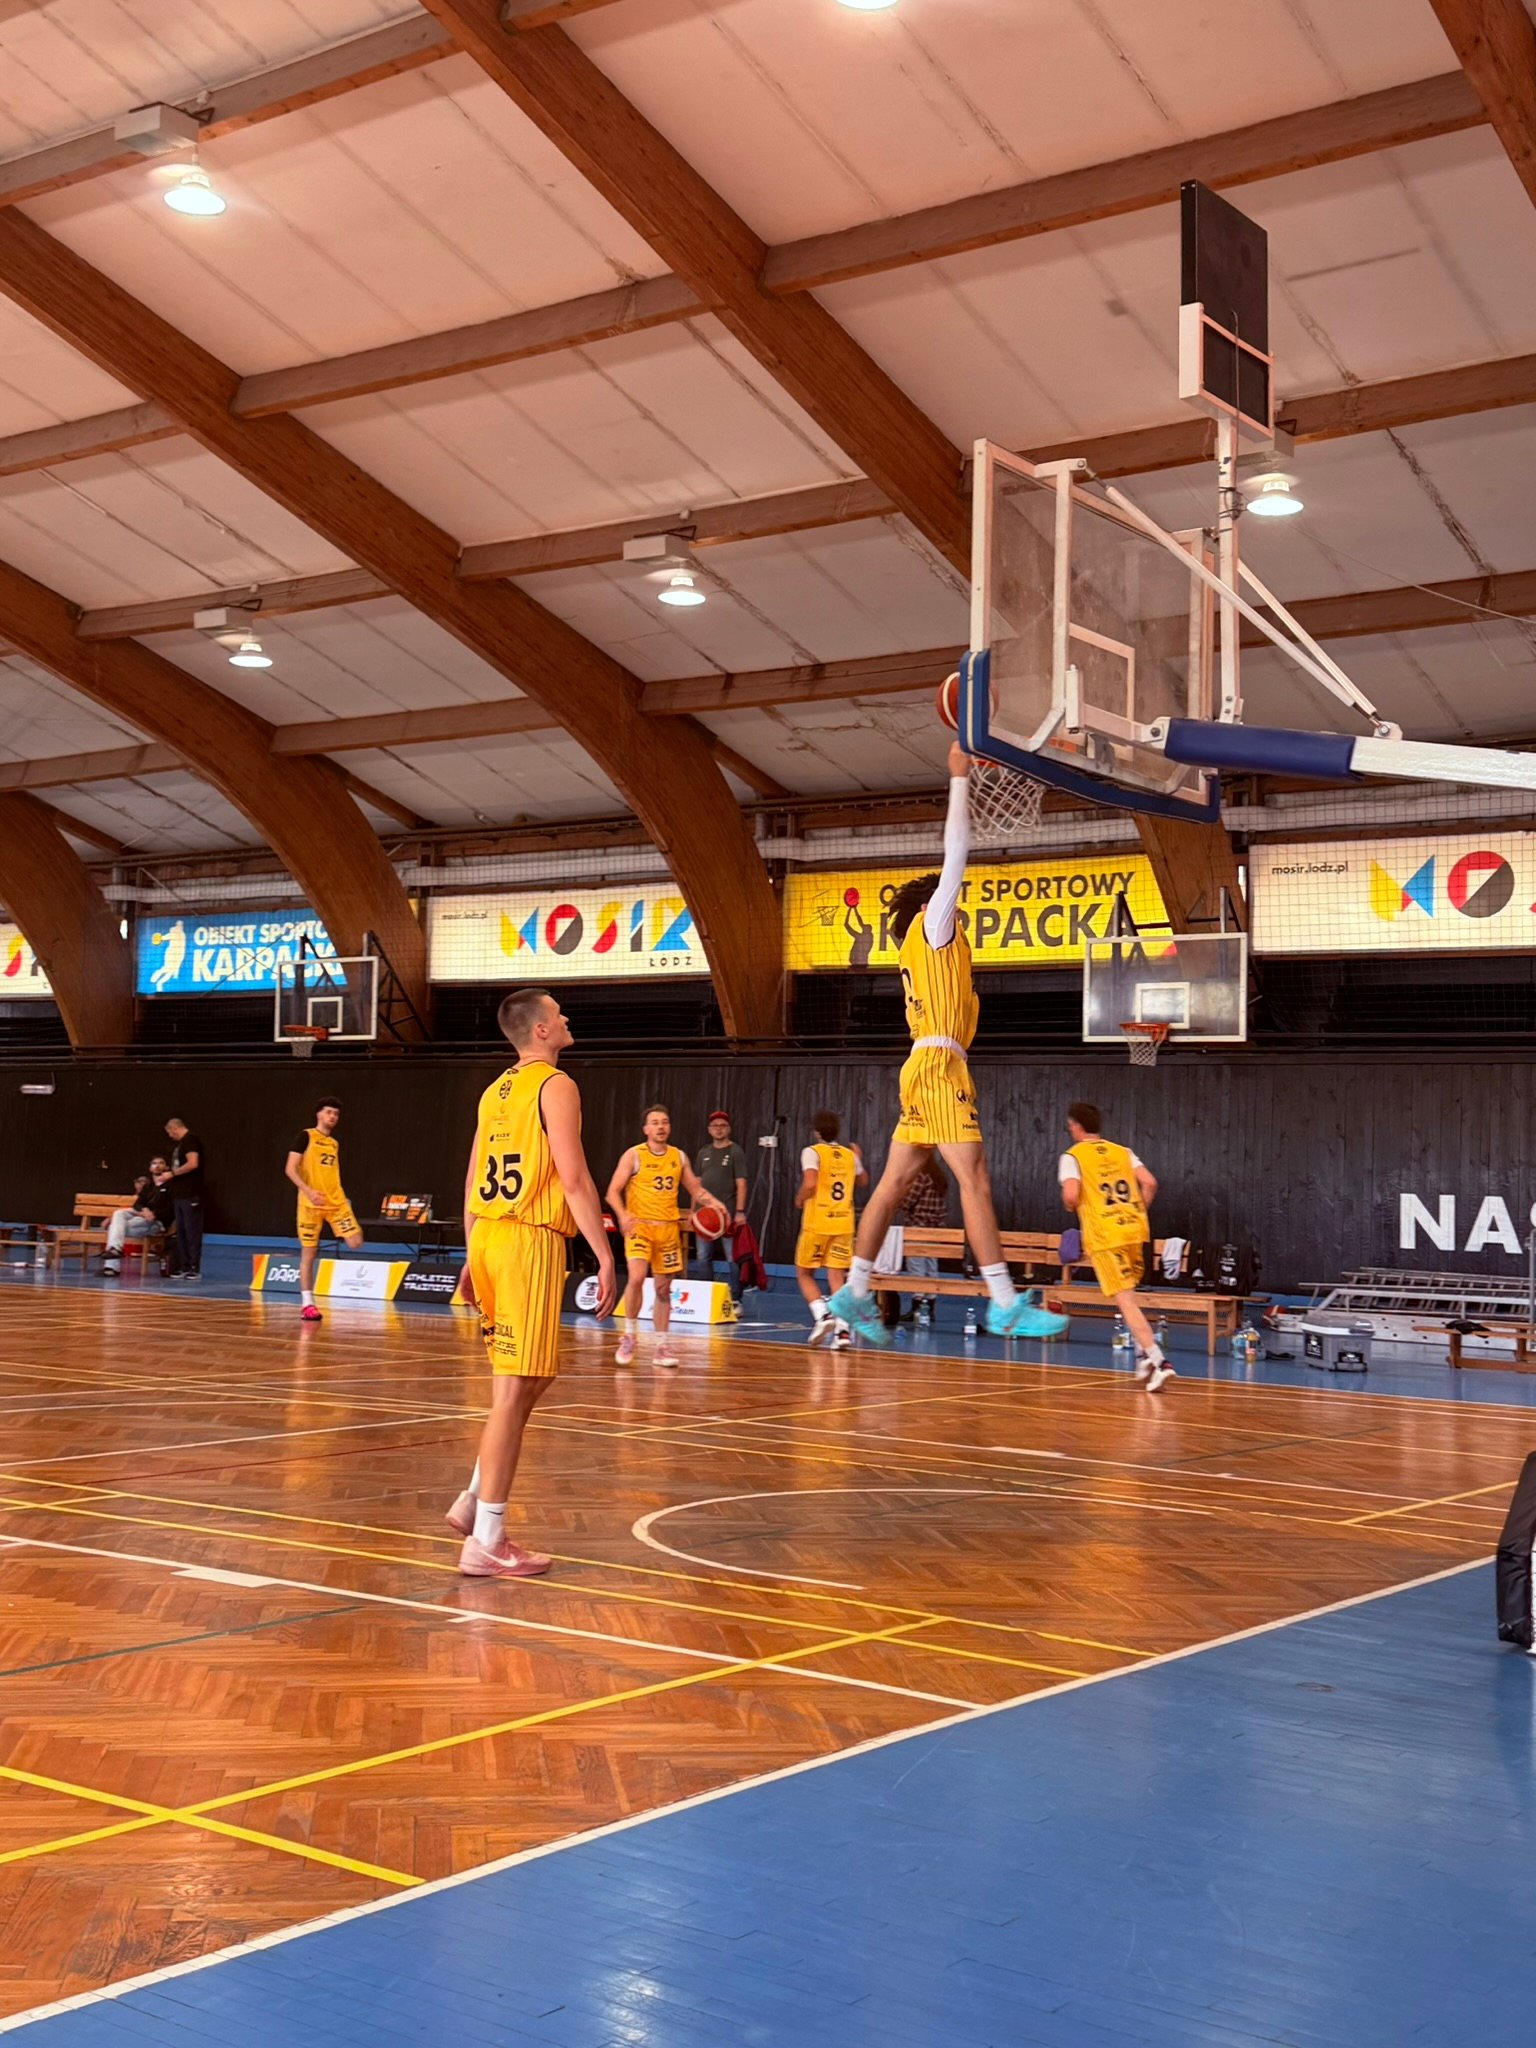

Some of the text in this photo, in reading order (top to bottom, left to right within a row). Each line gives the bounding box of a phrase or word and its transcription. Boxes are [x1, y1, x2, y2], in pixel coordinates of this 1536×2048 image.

[1272, 861, 1348, 874] mosir.lodz.pl
[981, 871, 1135, 902] SPORTOWY
[1368, 851, 1536, 922] MO
[193, 924, 257, 946] OBIEKT
[879, 901, 1140, 951] KPACKA
[321, 1153, 336, 1166] 27
[479, 1154, 523, 1201] 35
[654, 1176, 674, 1191] 33
[831, 1181, 845, 1201] 8
[1100, 1180, 1129, 1206] 29
[1400, 1193, 1536, 1254] NA
